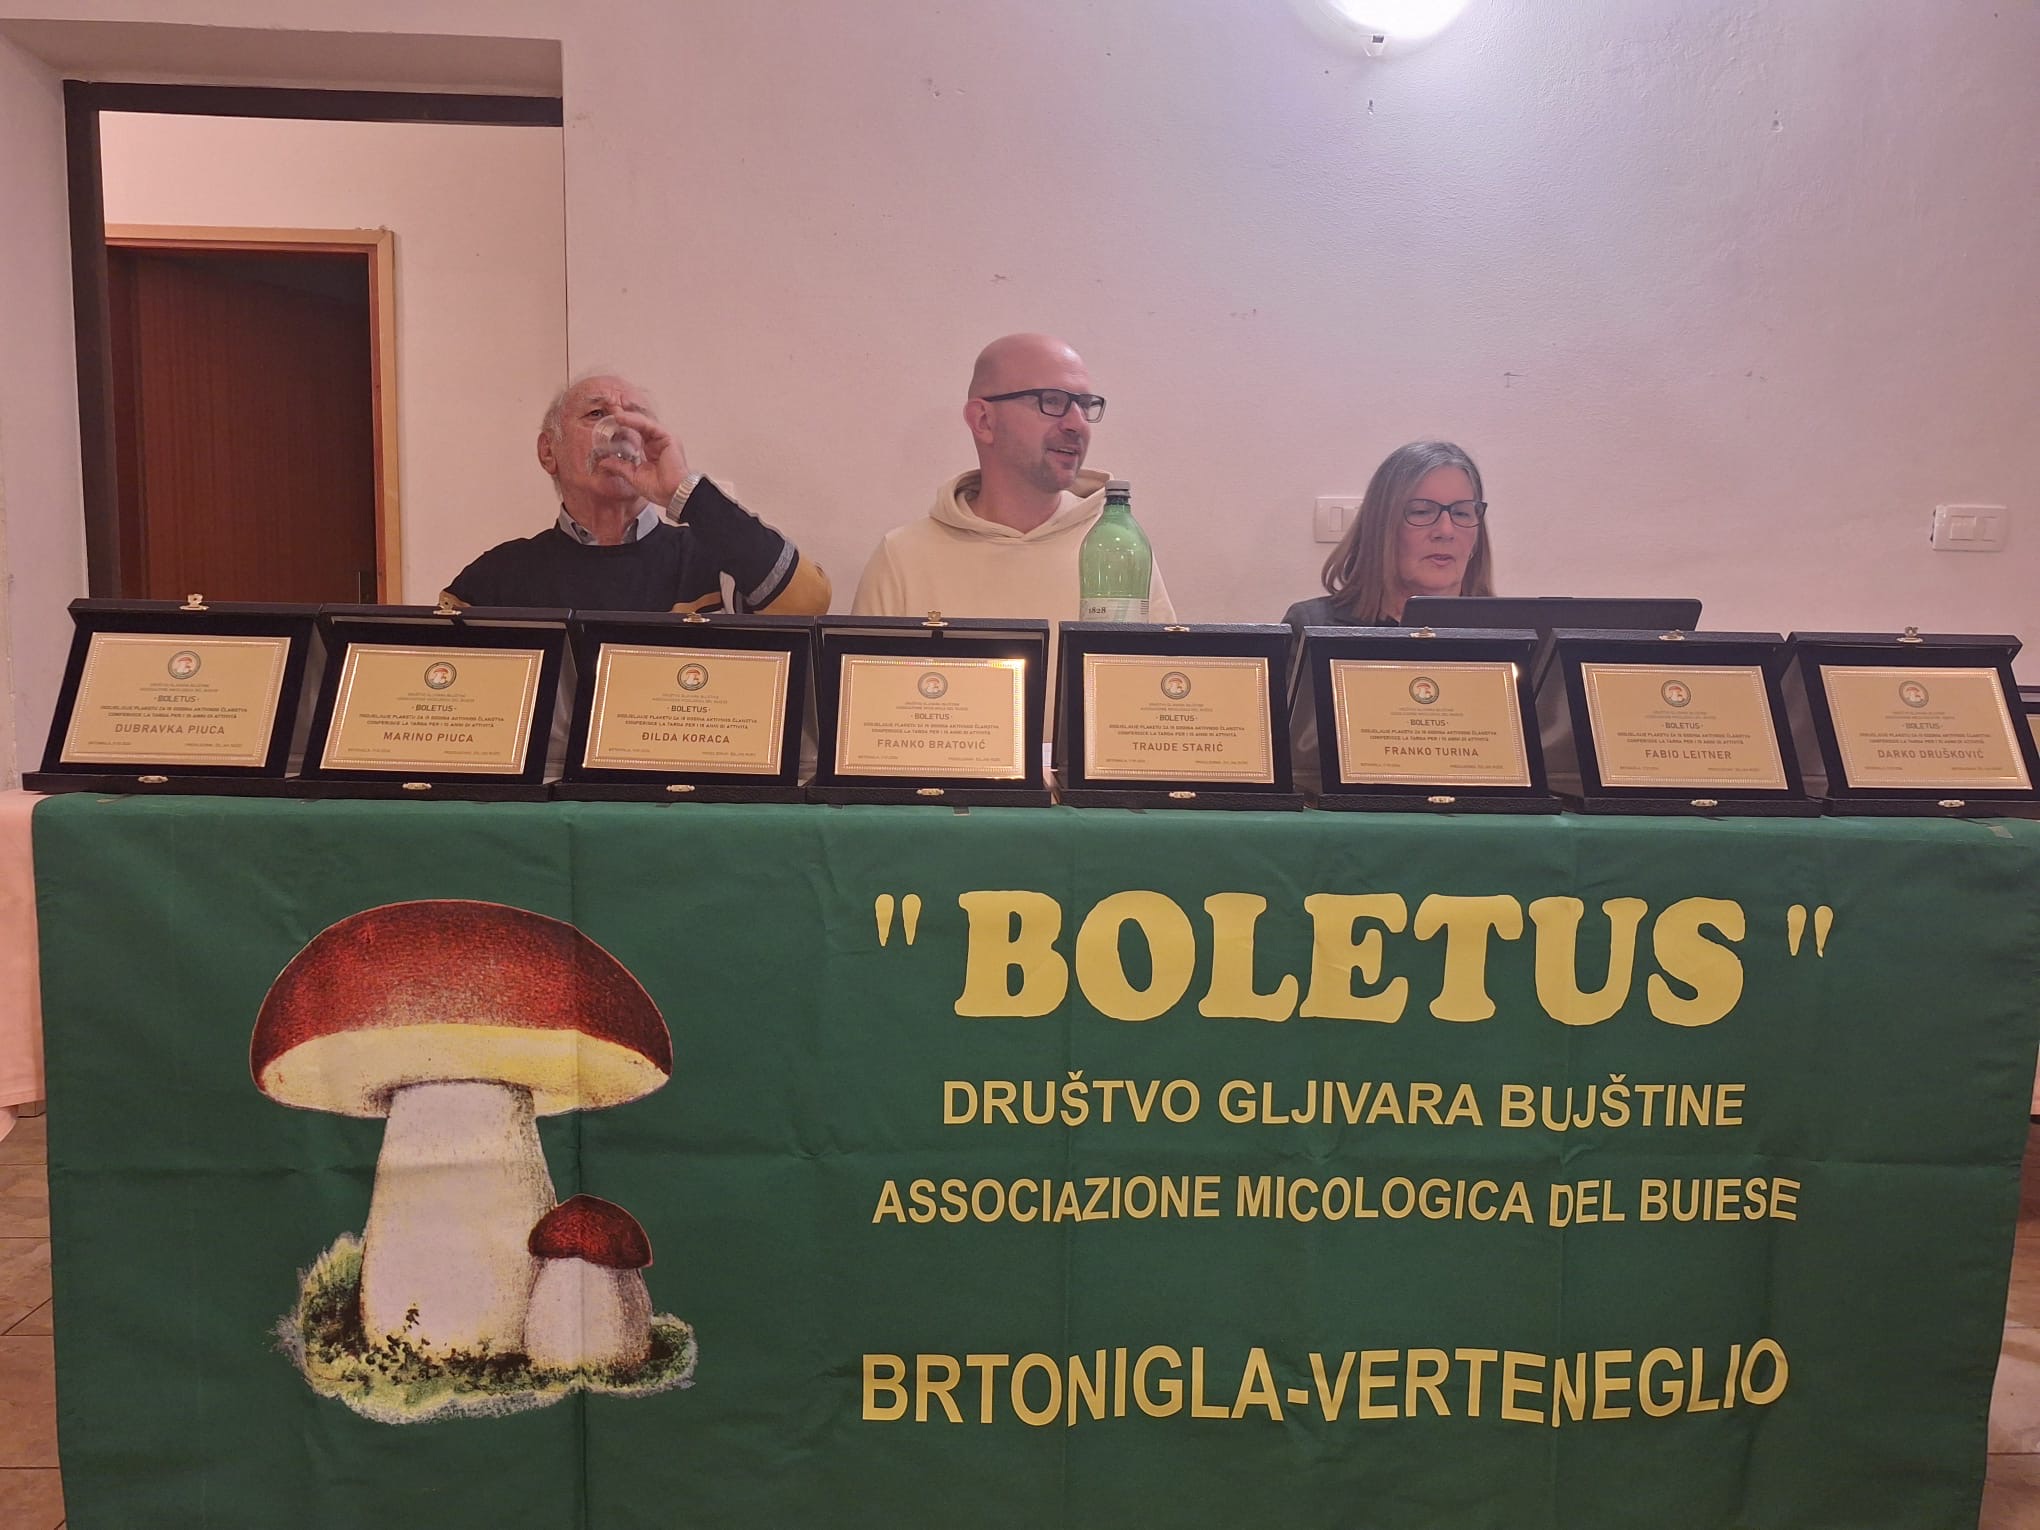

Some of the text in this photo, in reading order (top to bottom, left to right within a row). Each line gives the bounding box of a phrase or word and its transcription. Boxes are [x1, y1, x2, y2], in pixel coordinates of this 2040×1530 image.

[1088, 606, 1106, 614] 1828
[115, 723, 225, 735] DUBRAVKA PIUCA
[383, 731, 474, 743] MARINO PIUCA
[682, 733, 731, 744] KORACA
[877, 738, 986, 750] FRANKO BRATOVIĆ
[1132, 742, 1178, 751] TRAUDE
[1384, 746, 1479, 757] FRANKO TURINA
[1645, 749, 1732, 760] FABIO LEITNER
[1878, 749, 1916, 759] DARKO
[954, 890, 1745, 1026] BOLETUS
[943, 1070, 1746, 1132] DRUŠTVO GLJIVARA BUJŠTINE
[872, 1175, 1801, 1228] ASSOCIAZIONE MICOLOGICA DEL BUIESE
[862, 1338, 1789, 1428] BRTONIGLA-VERTENEGLIO
